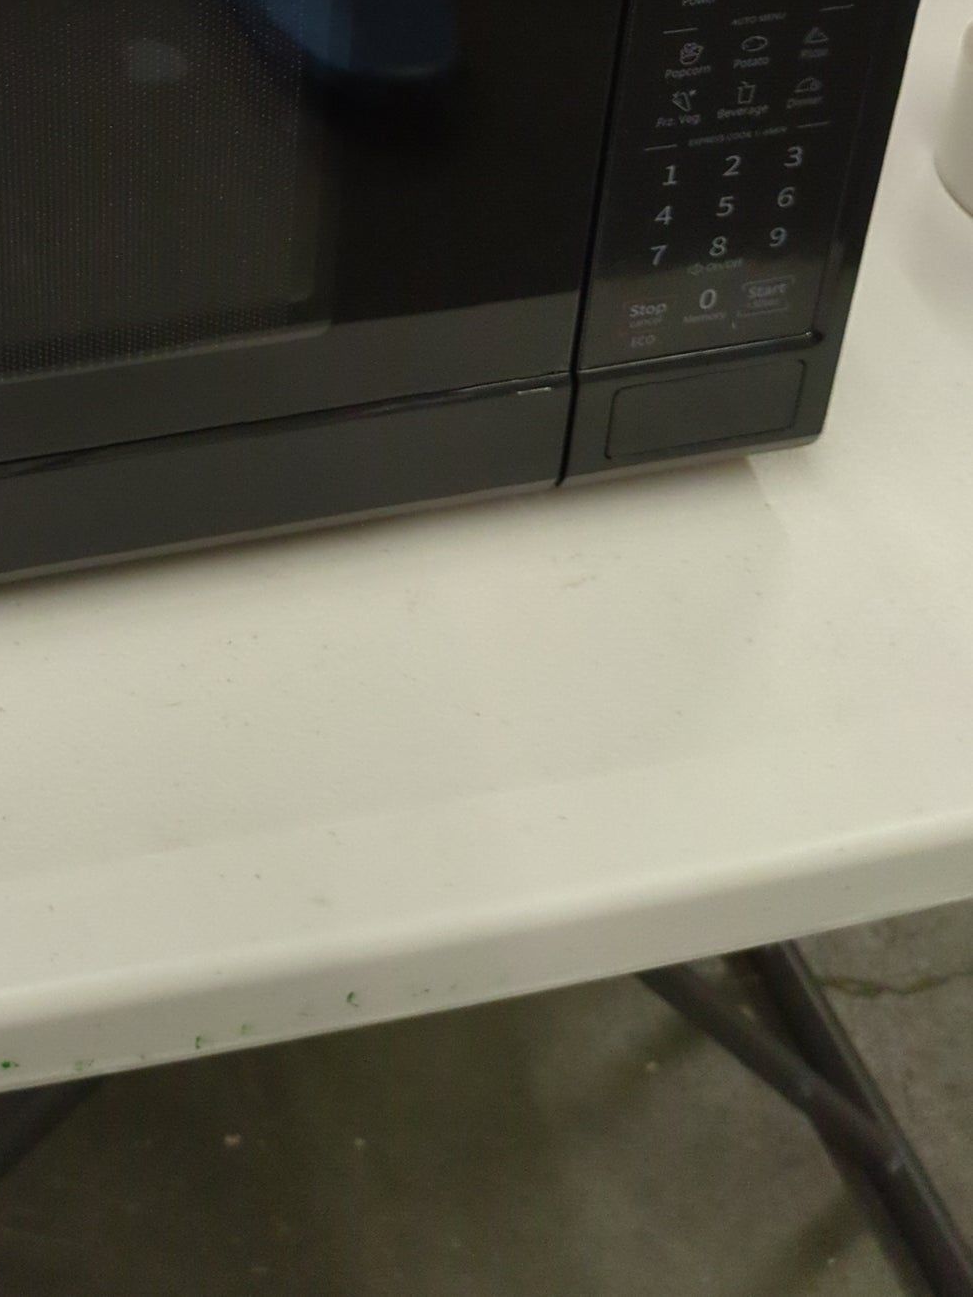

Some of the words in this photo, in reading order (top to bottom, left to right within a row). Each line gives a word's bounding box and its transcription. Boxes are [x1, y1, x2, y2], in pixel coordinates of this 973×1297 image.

[664, 65, 712, 80] Popcorn
[732, 56, 771, 69] Potato
[717, 104, 770, 119] Beverage
[722, 154, 742, 176] 2
[783, 145, 804, 168] 3
[662, 164, 678, 186] 1
[715, 195, 735, 218] 5
[777, 186, 796, 208] 6
[654, 205, 673, 225] 4
[709, 235, 727, 257] 8
[769, 226, 787, 248] 9
[650, 244, 668, 266] 7
[699, 288, 717, 310] 0
[629, 303, 668, 318] Stop
